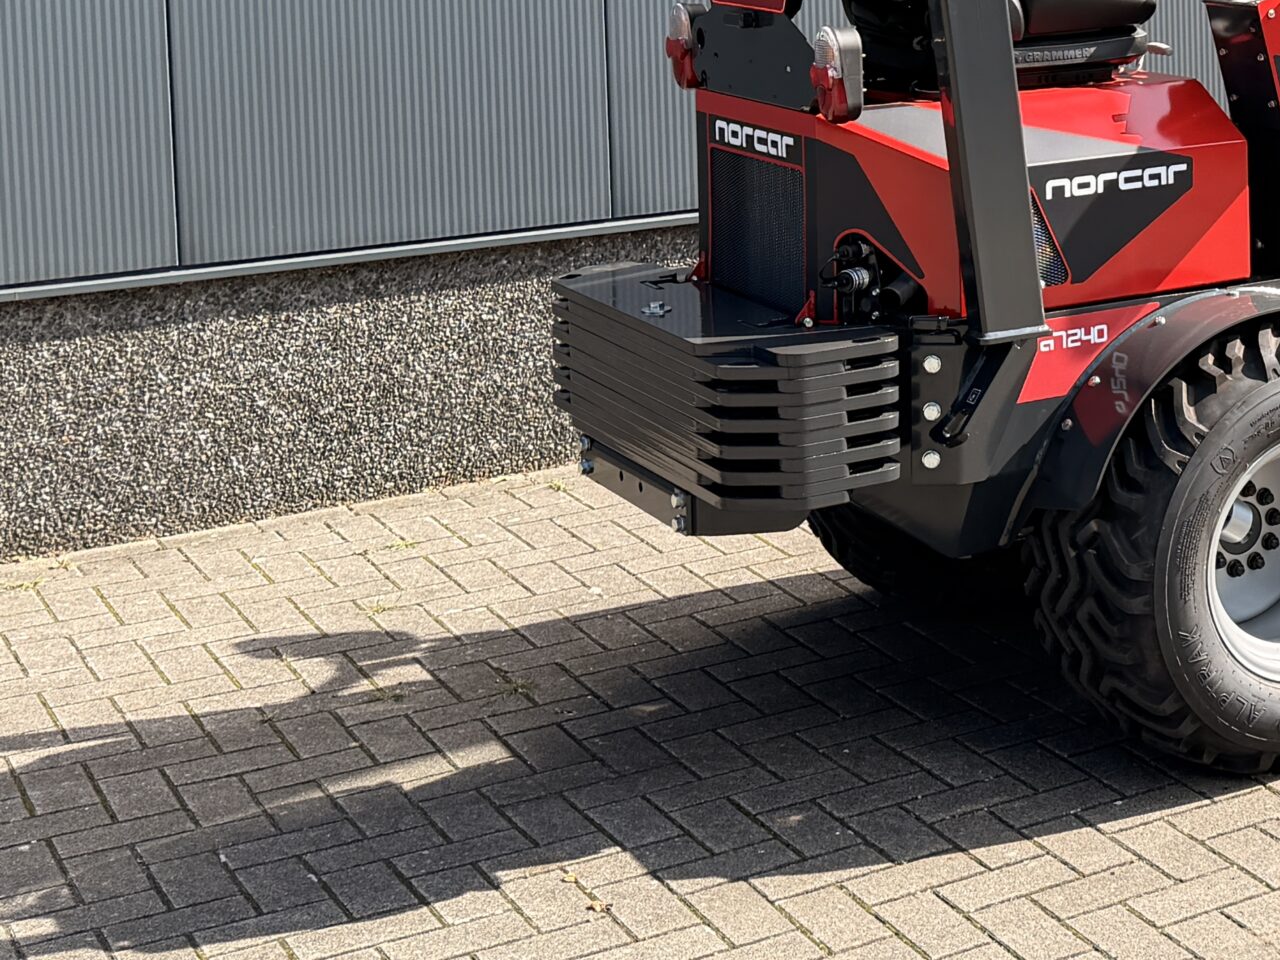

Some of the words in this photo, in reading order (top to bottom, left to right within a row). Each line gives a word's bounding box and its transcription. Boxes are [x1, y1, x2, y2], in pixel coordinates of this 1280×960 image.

[1025, 47, 1090, 62] GRAMMER
[715, 120, 794, 158] norcar
[1045, 163, 1187, 200] norcar
[1178, 624, 1267, 727] ALPTRAK
